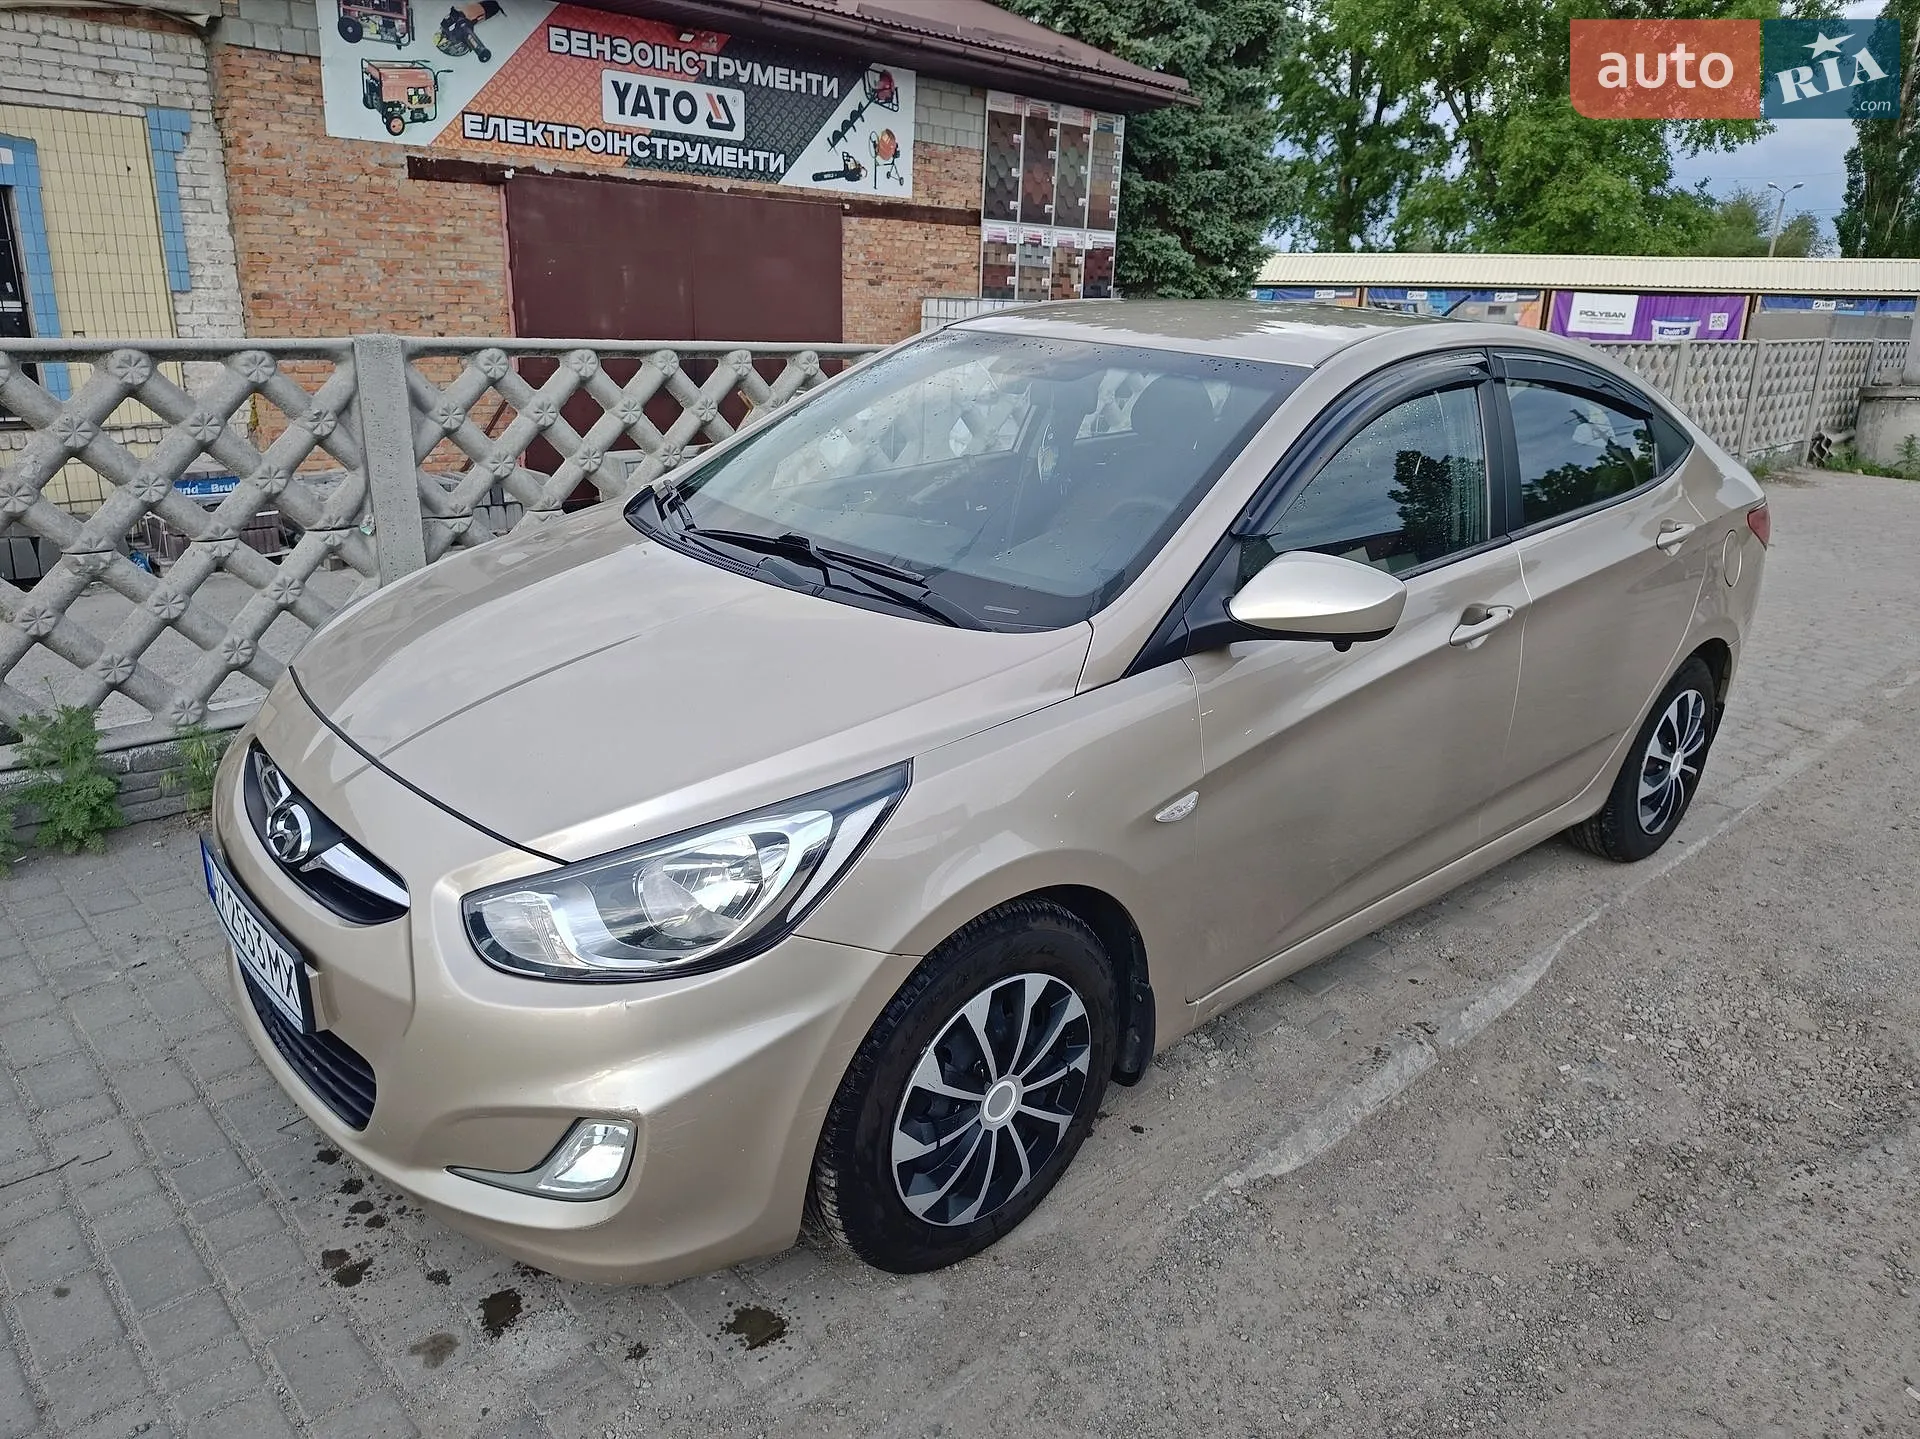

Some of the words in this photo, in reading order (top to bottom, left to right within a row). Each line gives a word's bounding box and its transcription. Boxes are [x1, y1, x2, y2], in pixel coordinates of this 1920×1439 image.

[547, 27, 840, 99] БЕНЗОІНСТРУМЕНТИ
[611, 80, 699, 125] YATO
[463, 114, 786, 174] ЕЛЕКТРОІНСТРУМЕНТИ
[1579, 310, 1626, 319] POLYSAN
